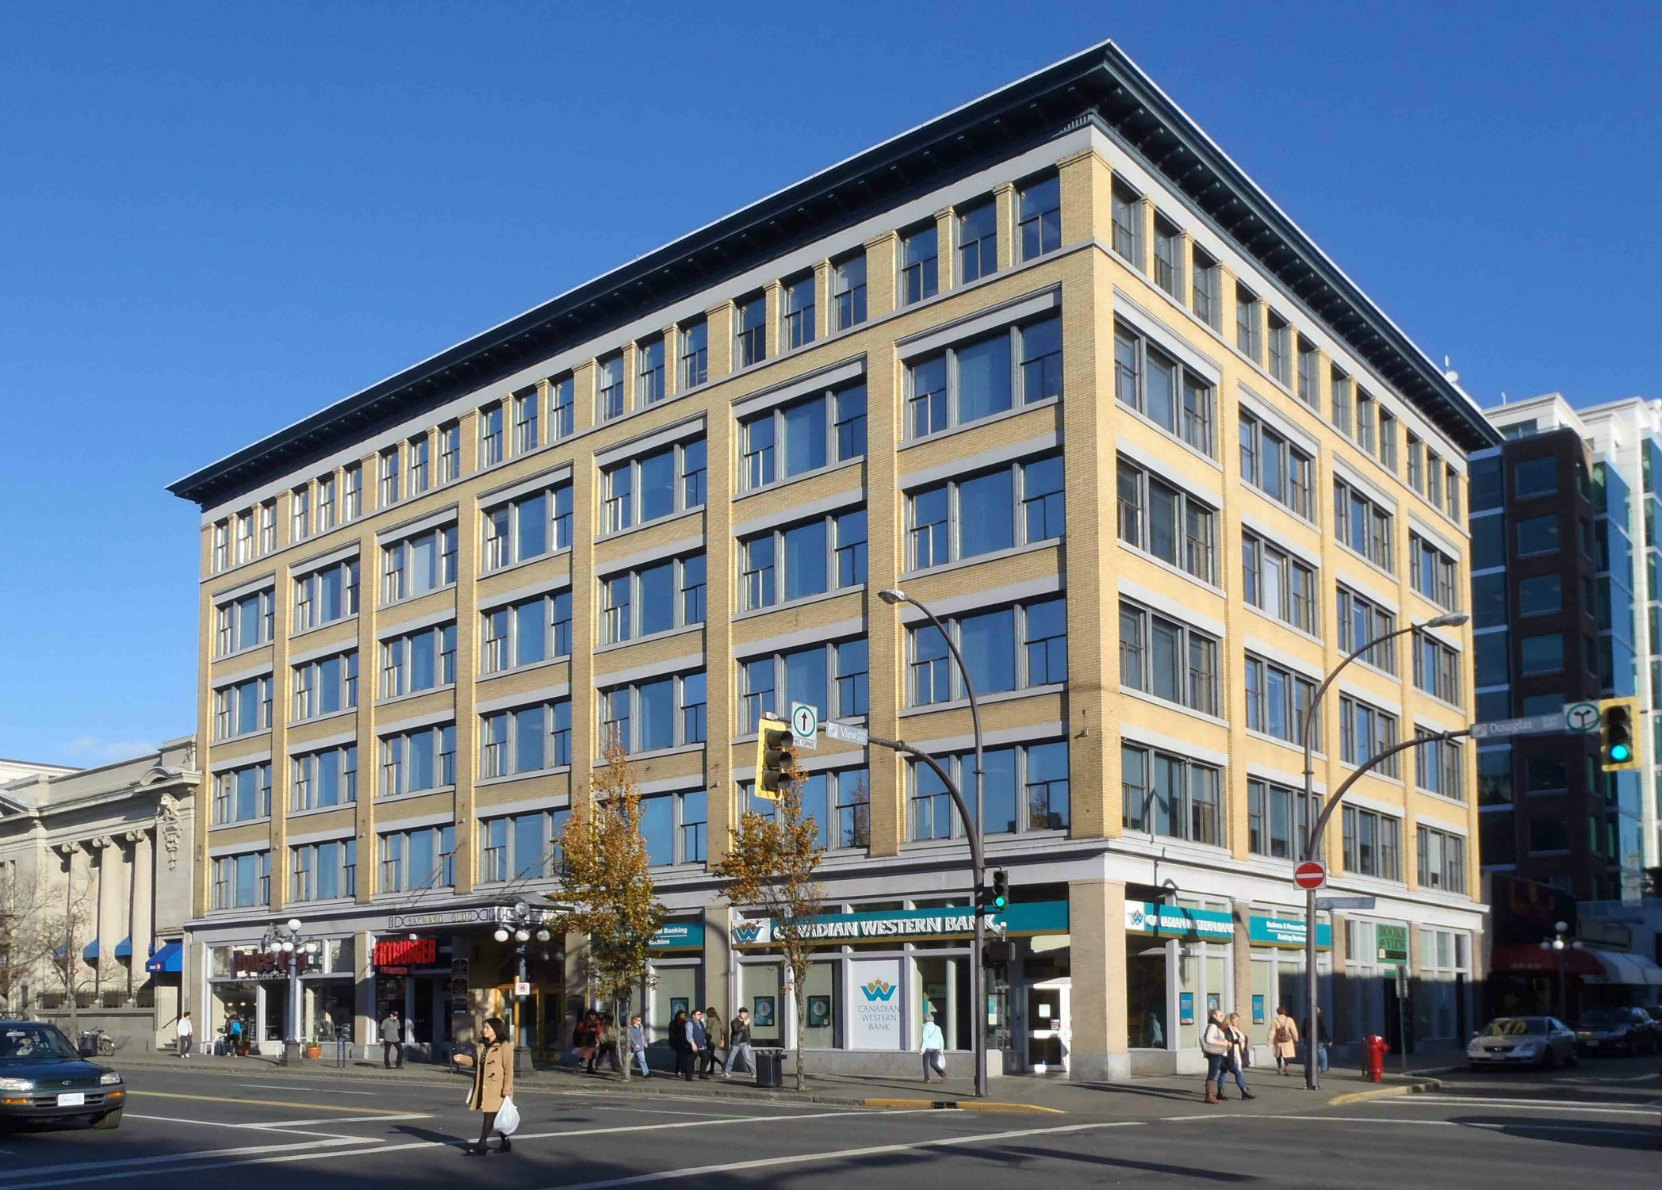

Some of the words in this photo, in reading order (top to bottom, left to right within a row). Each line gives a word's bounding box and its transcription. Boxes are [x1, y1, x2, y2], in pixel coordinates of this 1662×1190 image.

[840, 727, 857, 739] View
[1490, 720, 1533, 734] Douglas
[773, 921, 859, 940] CNADIAN
[860, 917, 941, 936] WESTERN
[1379, 924, 1406, 938] BOOKS
[858, 1005, 900, 1013] CANADIAN
[861, 1013, 897, 1021] WESTERN
[868, 1023, 890, 1031] BANK
